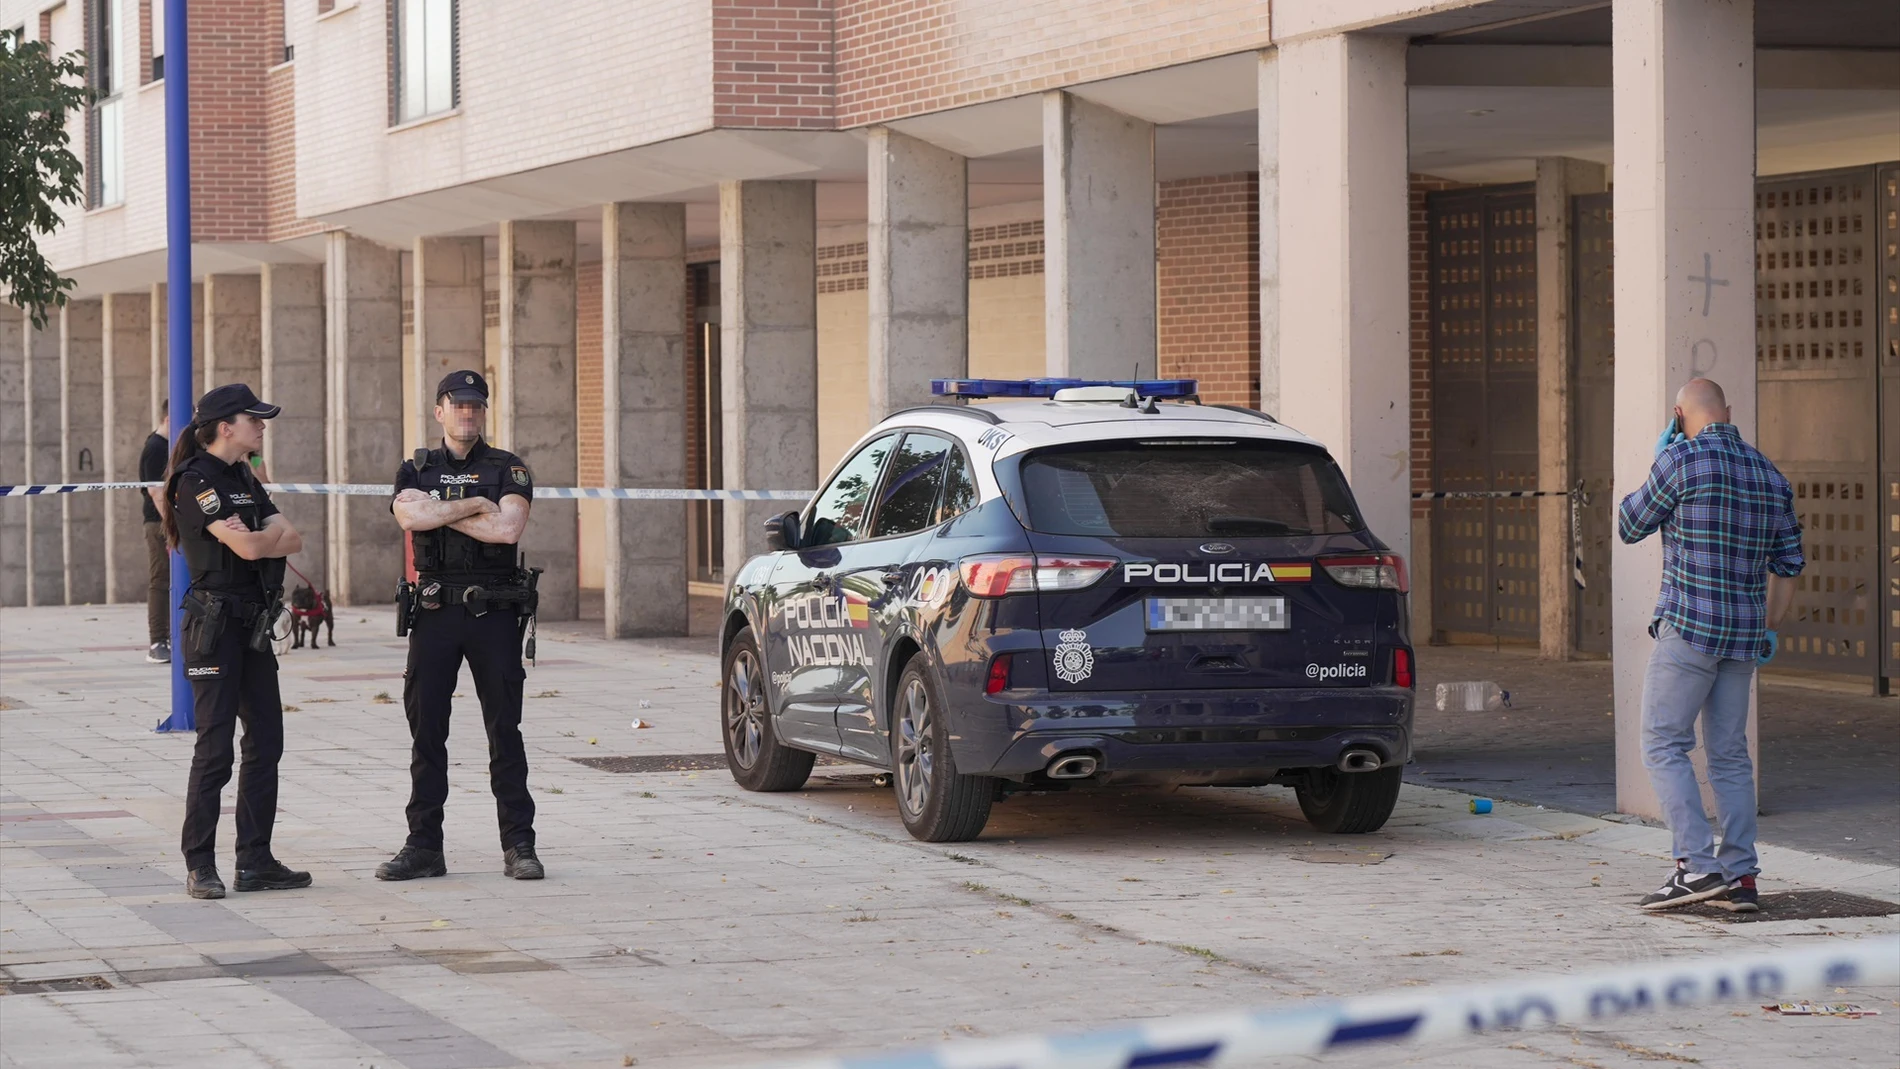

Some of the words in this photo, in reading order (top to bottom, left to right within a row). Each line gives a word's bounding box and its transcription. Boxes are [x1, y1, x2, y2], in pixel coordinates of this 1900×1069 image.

[78, 447, 94, 471] A
[787, 633, 873, 666] NACIONAL
[1305, 663, 1367, 681] @policia
